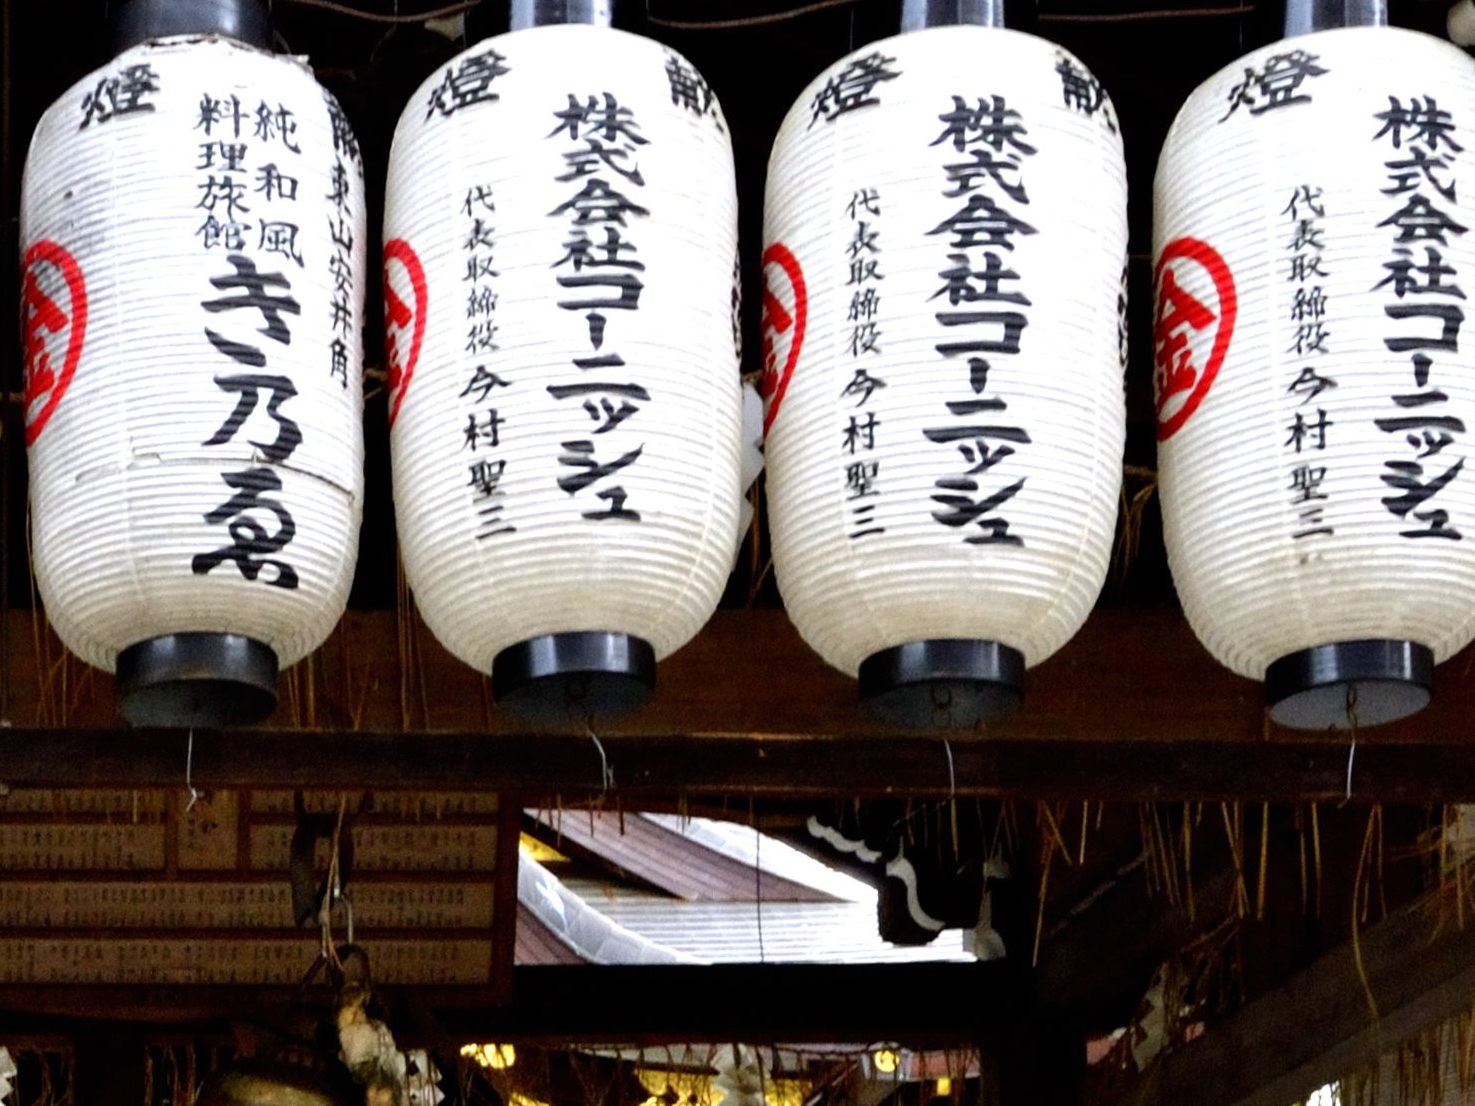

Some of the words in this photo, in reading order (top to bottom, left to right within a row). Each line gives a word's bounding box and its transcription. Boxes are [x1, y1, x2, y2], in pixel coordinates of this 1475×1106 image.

[193, 93, 252, 251] 料理旅館
[253, 101, 305, 269] 純和風
[545, 92, 652, 521] 株式会社コーニッシュ
[923, 95, 1039, 547] 株式会社コーニッシュ
[1371, 95, 1469, 541] 株式会社コーニッシュ
